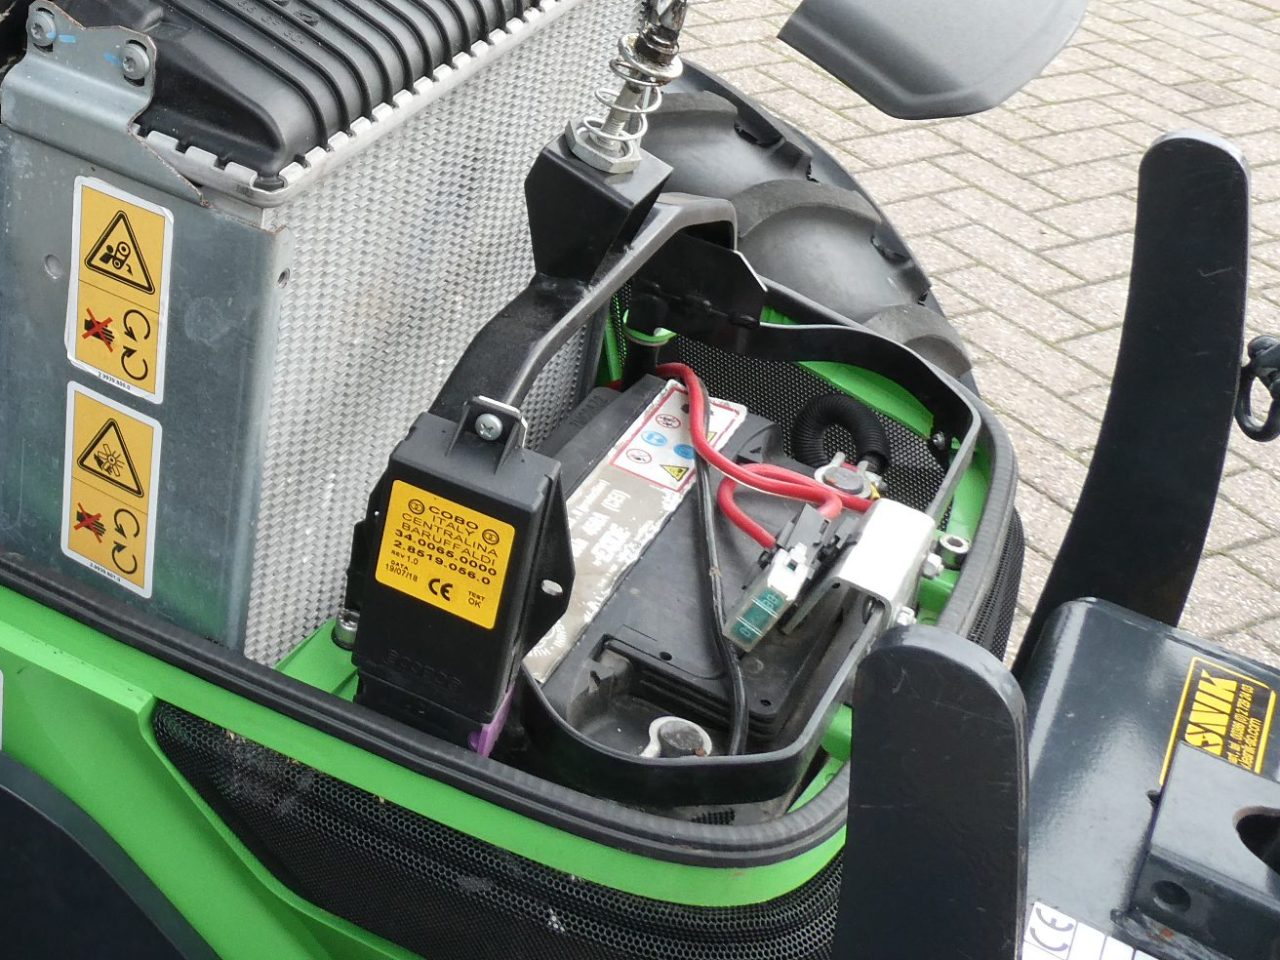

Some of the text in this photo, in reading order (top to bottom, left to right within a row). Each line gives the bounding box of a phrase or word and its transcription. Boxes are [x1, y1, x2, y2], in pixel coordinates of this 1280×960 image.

[428, 505, 479, 530] COBO
[431, 515, 475, 537] ITALY
[401, 512, 498, 558] CENTRALINA
[401, 522, 496, 566] BARUFFALDI
[394, 529, 497, 576] 34.0065.0000
[390, 559, 409, 572] DATA
[428, 578, 454, 602] CE
[468, 590, 486, 602] TEST
[468, 597, 482, 609] OK
